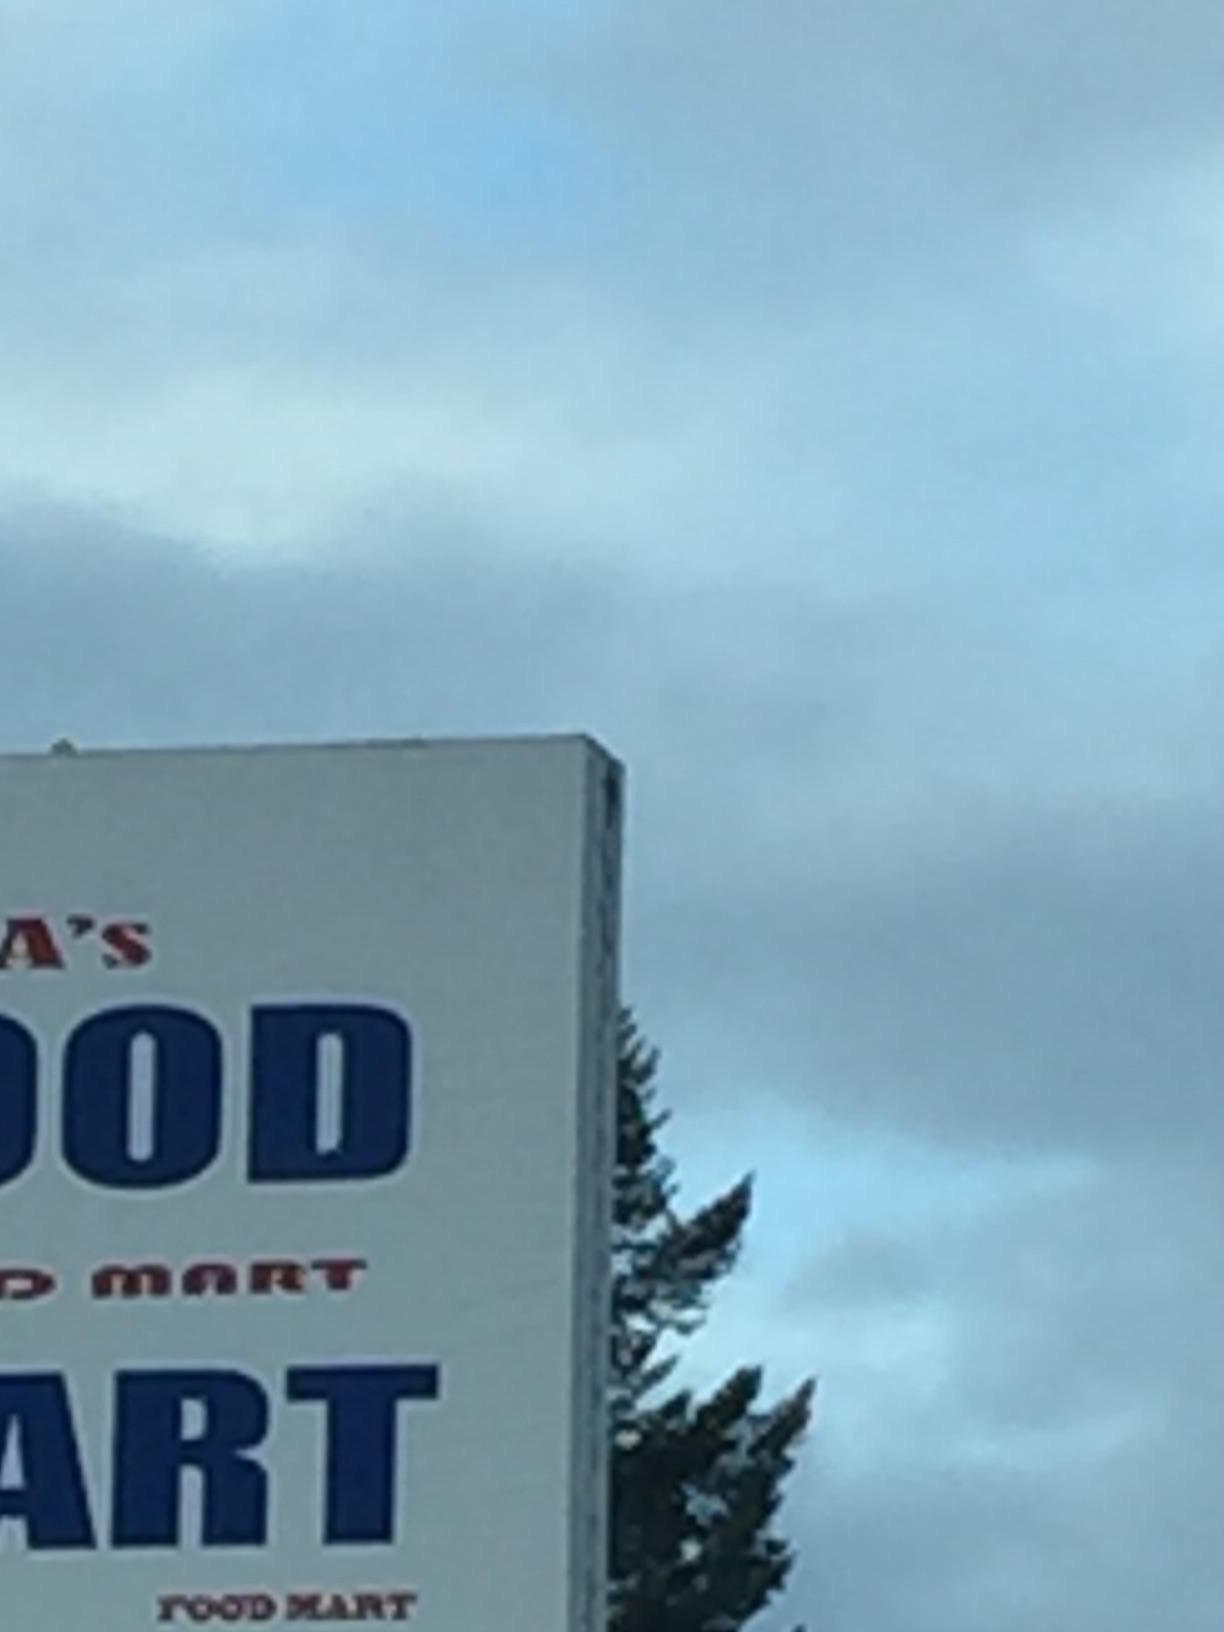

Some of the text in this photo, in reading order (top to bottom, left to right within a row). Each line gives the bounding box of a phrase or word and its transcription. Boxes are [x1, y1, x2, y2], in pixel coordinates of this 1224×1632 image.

[90, 1258, 367, 1299] MART
[157, 1592, 417, 1623] FOOD MART
